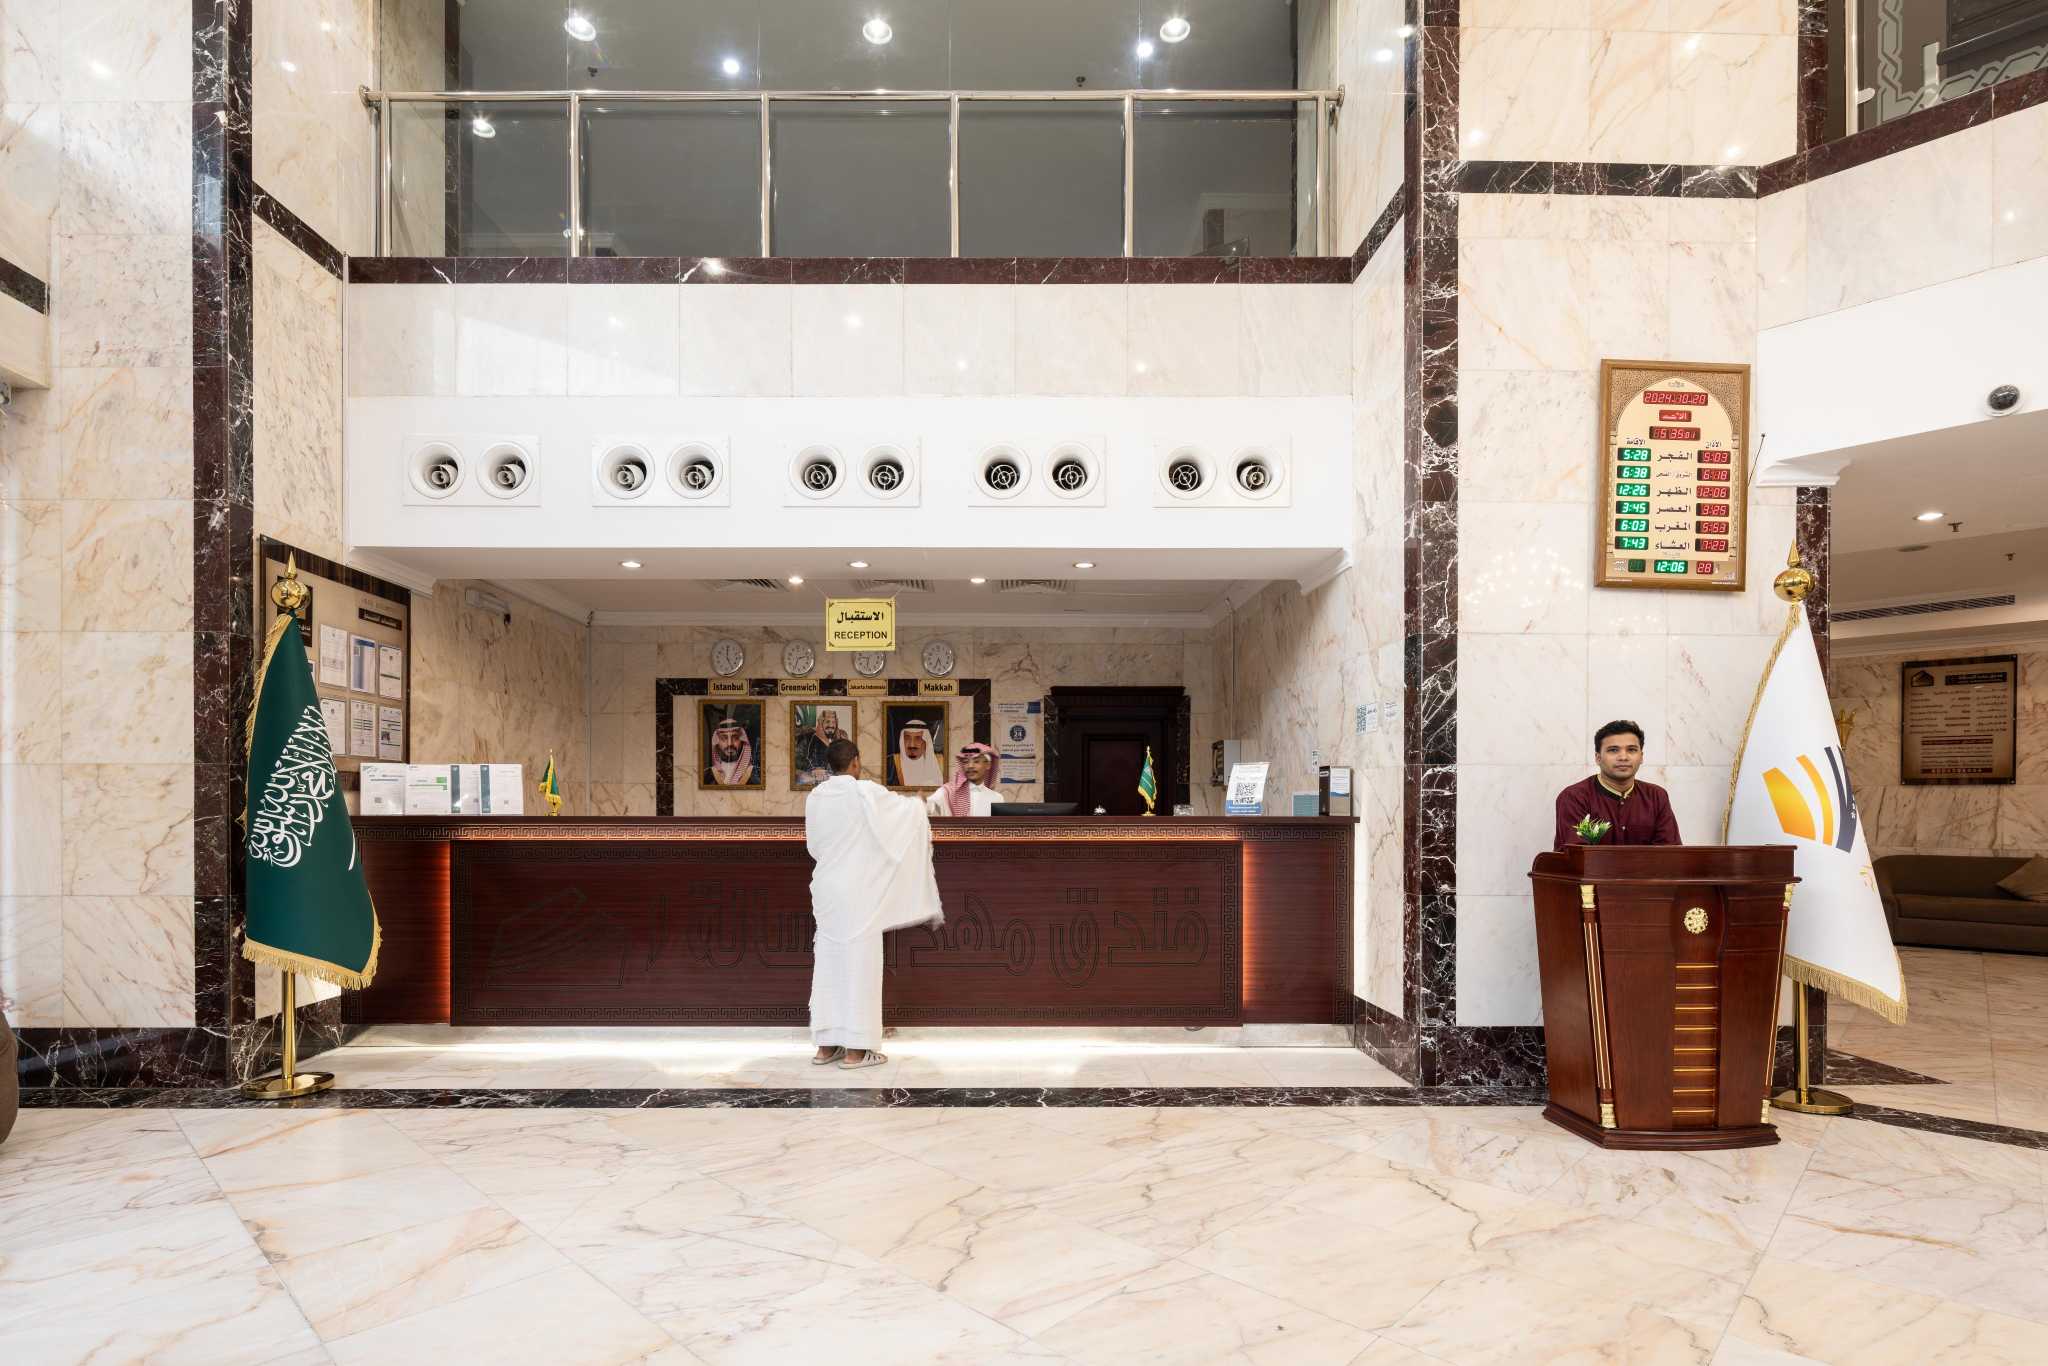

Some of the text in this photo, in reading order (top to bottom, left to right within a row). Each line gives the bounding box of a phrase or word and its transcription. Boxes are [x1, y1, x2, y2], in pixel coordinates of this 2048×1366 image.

[1623, 449, 1648, 460] 5:28
[1656, 450, 1692, 463] الفجر
[1623, 467, 1648, 478] 6:38
[1619, 485, 1647, 496] 12:26
[1622, 502, 1646, 513] 3:45
[1621, 520, 1646, 531] 6:03
[1655, 521, 1691, 533] المغرب
[1622, 538, 1646, 549] 7:43
[1657, 561, 1686, 573] 12:06
[837, 610, 884, 624] الاستقبال
[834, 631, 888, 640] RECEPTION
[713, 682, 744, 691] Istanbul
[780, 682, 817, 692] Greenwich
[924, 683, 952, 692] Makkah
